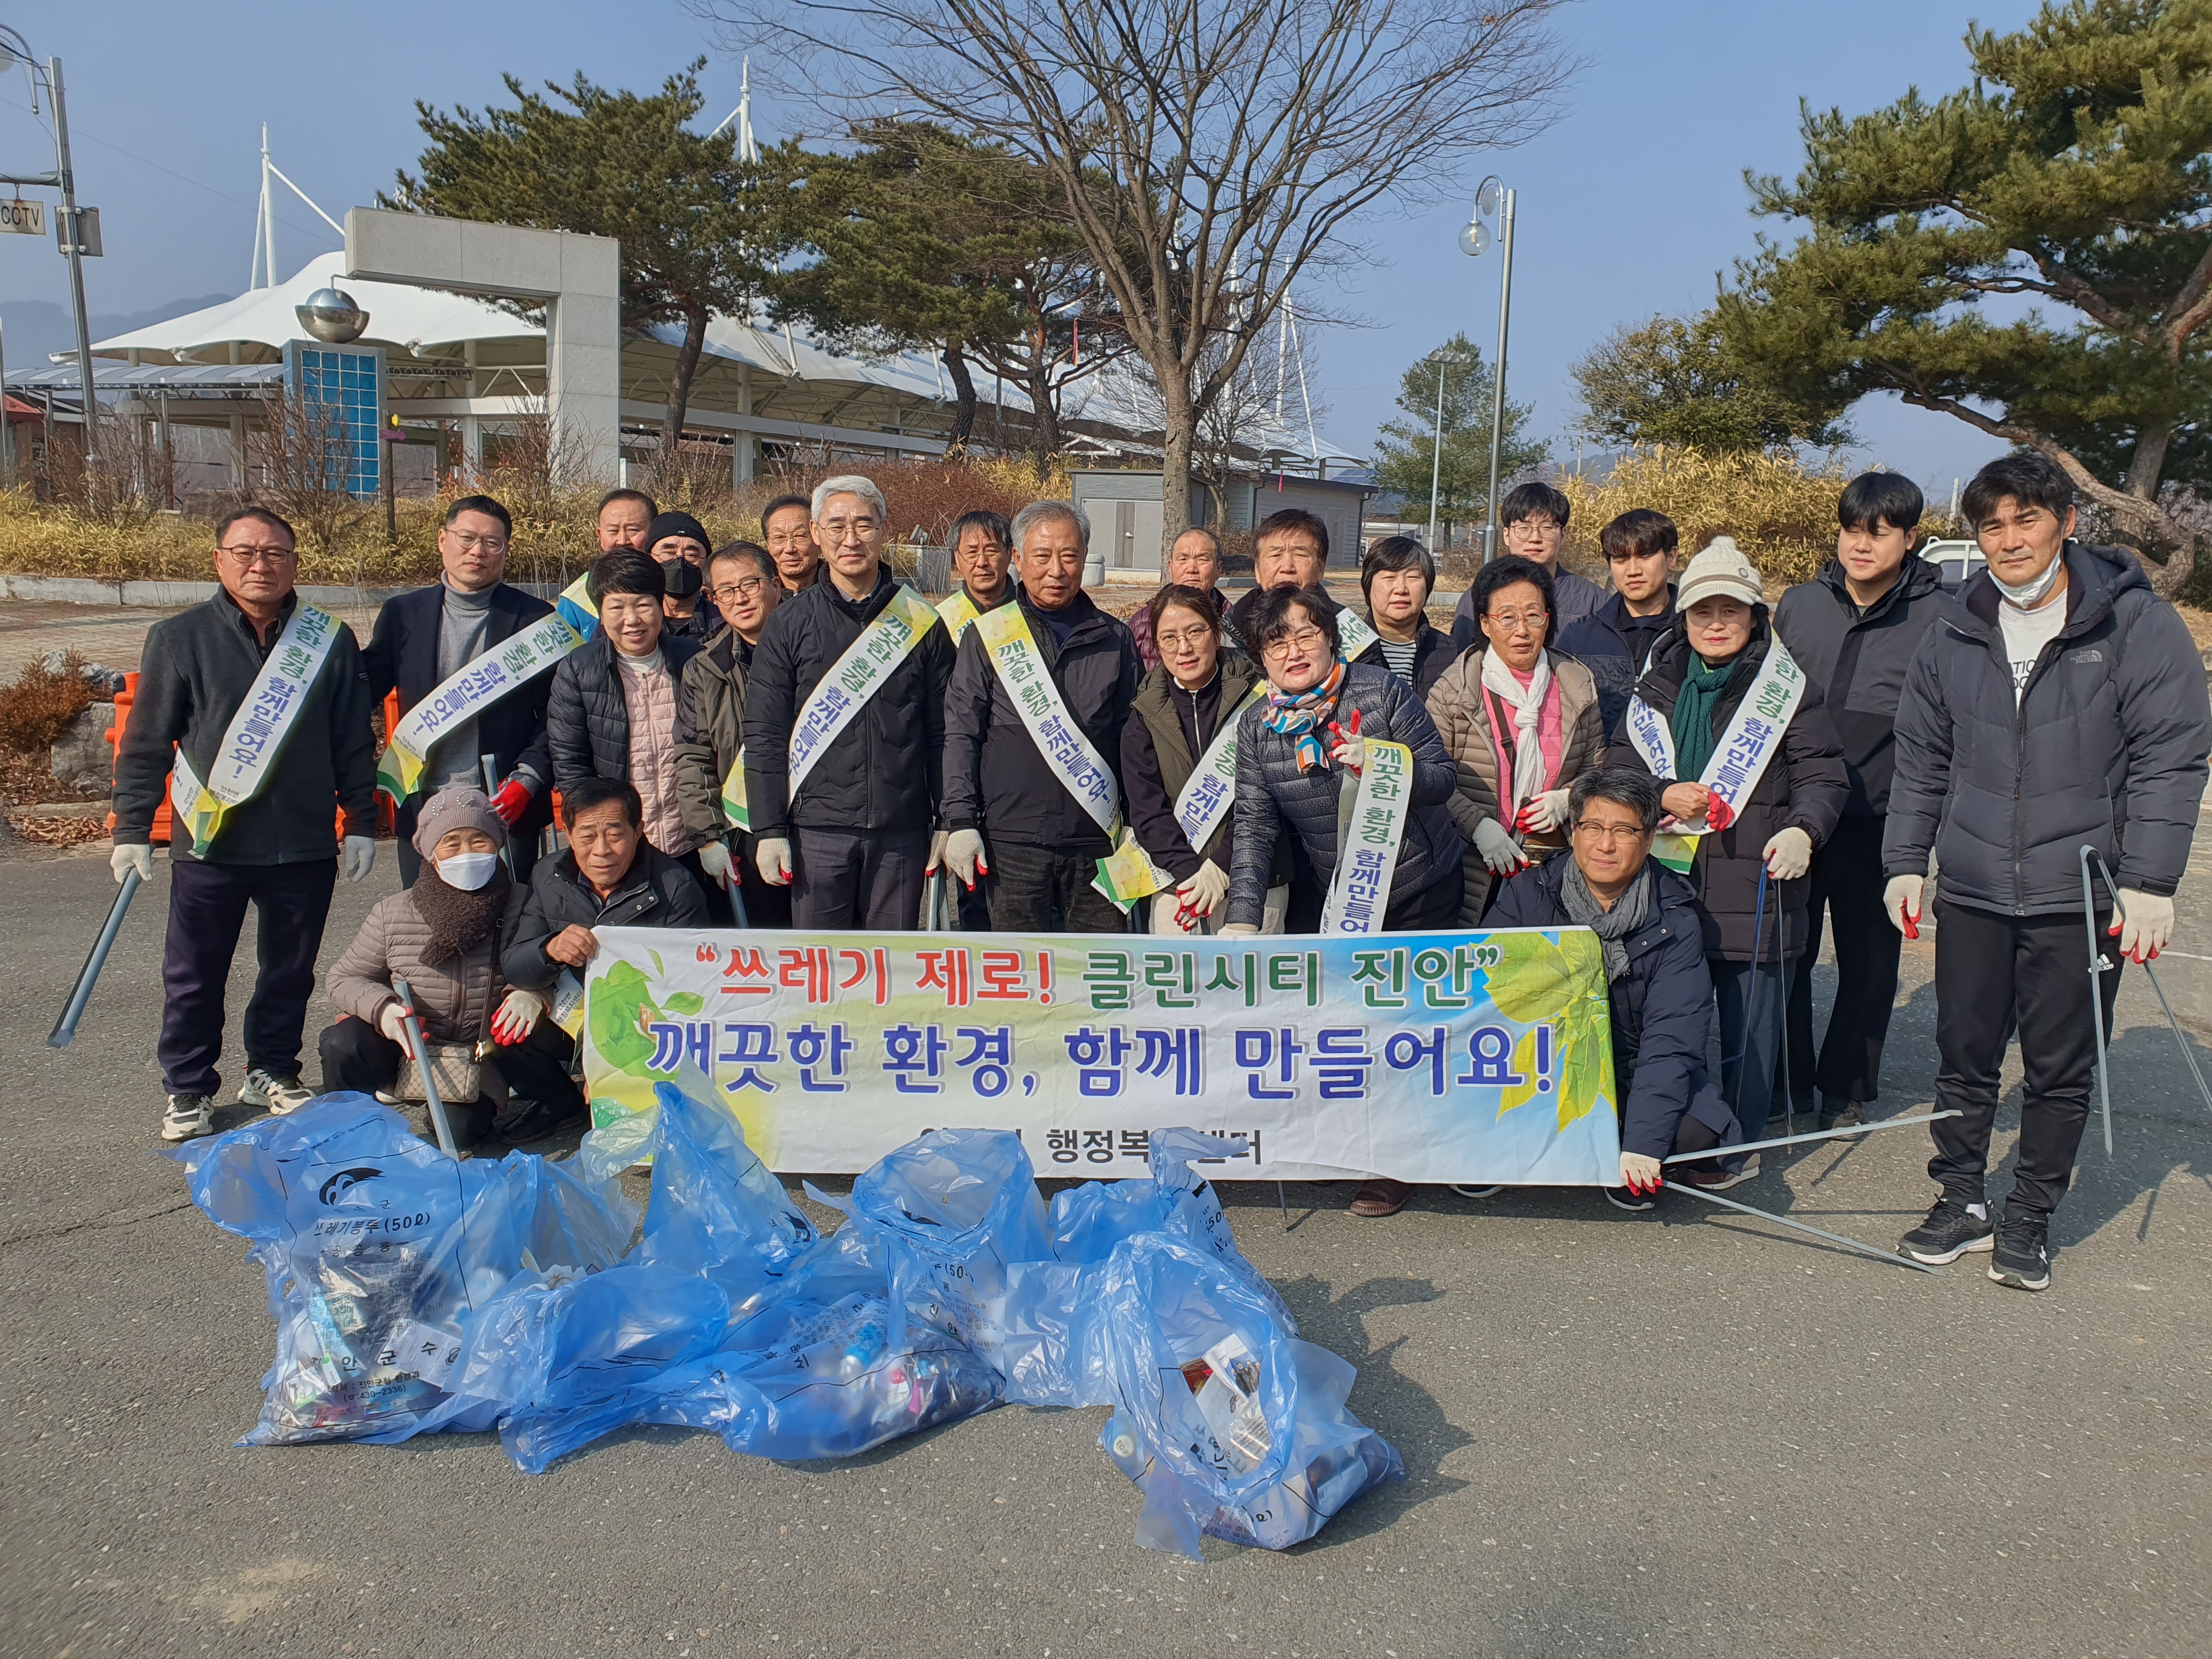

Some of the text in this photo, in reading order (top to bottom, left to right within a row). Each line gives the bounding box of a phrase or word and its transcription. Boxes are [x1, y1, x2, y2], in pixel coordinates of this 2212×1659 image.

[1, 206, 39, 227] CCTV
[866, 614, 913, 664] 깨끗한
[997, 638, 1036, 684] 깨끗한
[1370, 747, 1403, 801] 깨끗한
[916, 948, 1052, 1006] 제로!
[1082, 950, 1317, 1008] 클린시티
[648, 1023, 1554, 1099] 깨끗한 환경, 함께 만들어요!
